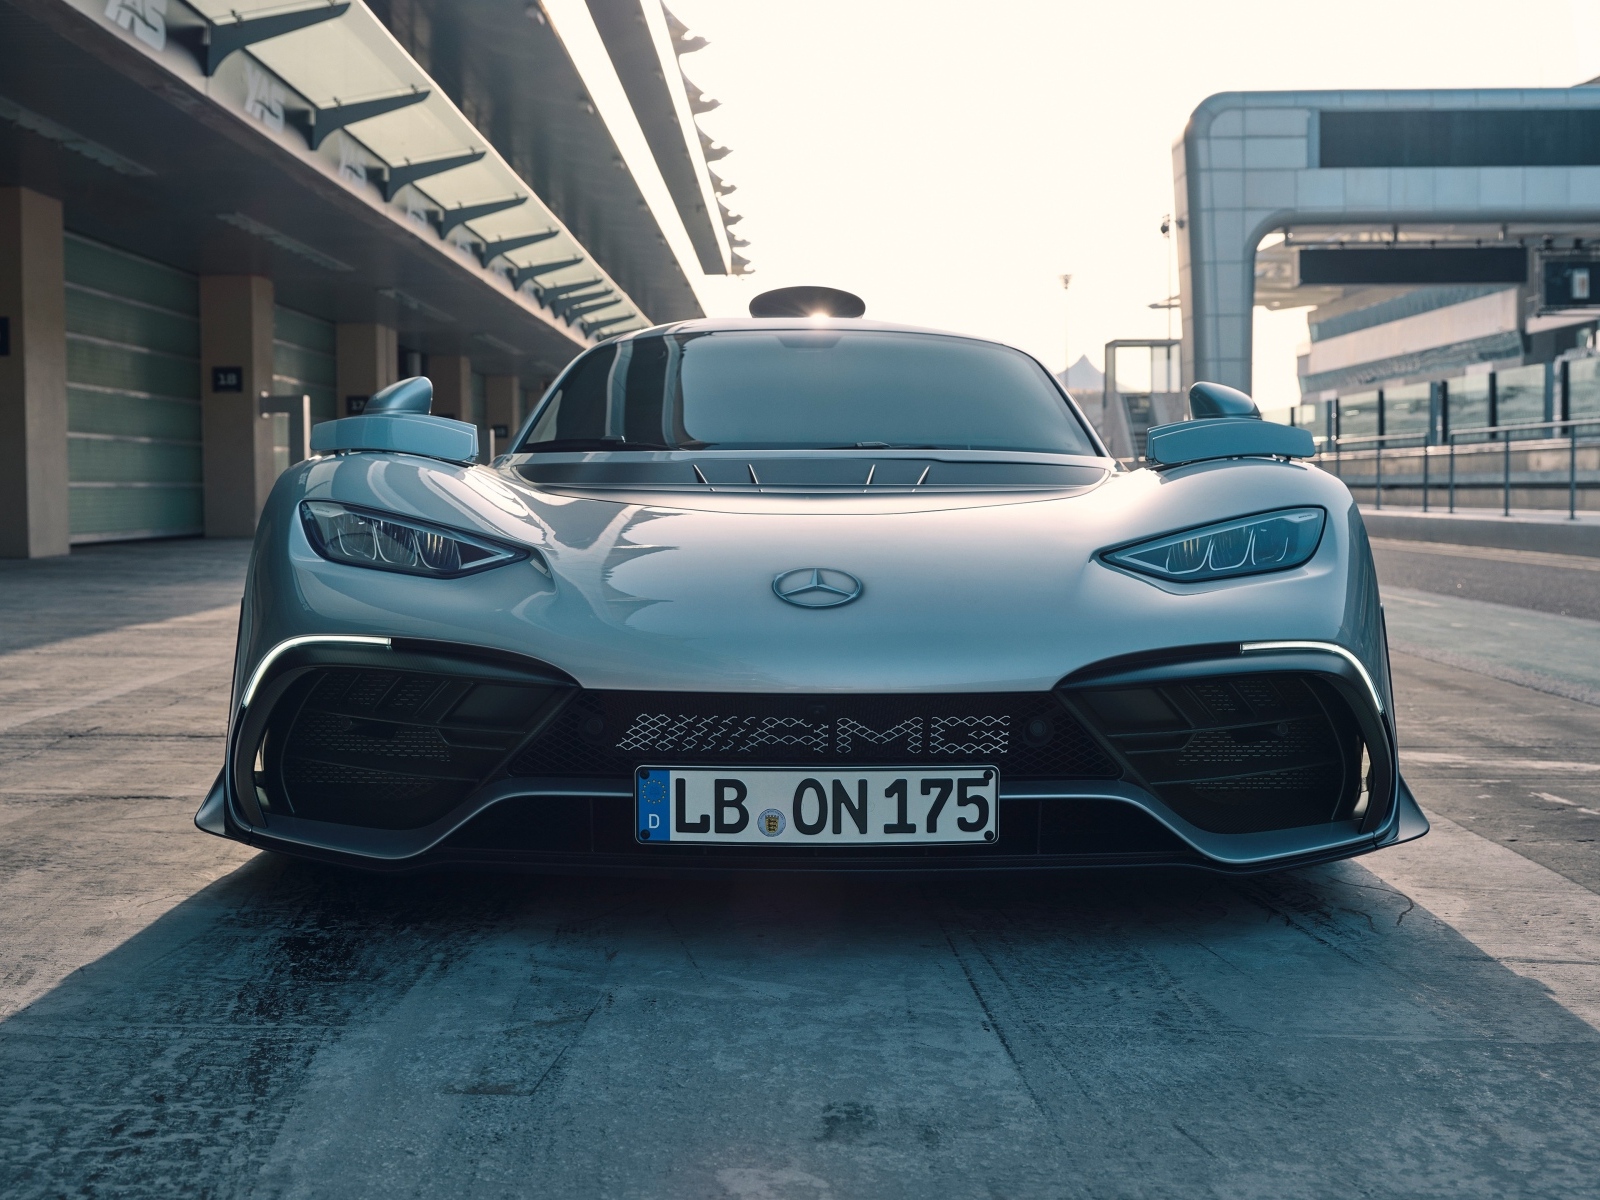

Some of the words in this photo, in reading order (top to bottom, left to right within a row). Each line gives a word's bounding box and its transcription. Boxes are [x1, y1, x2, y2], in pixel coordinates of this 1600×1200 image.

[738, 716, 1011, 754] AMG
[648, 813, 660, 829] D
[675, 778, 749, 834] LB
[792, 778, 868, 836] ON
[883, 777, 990, 834] 175
